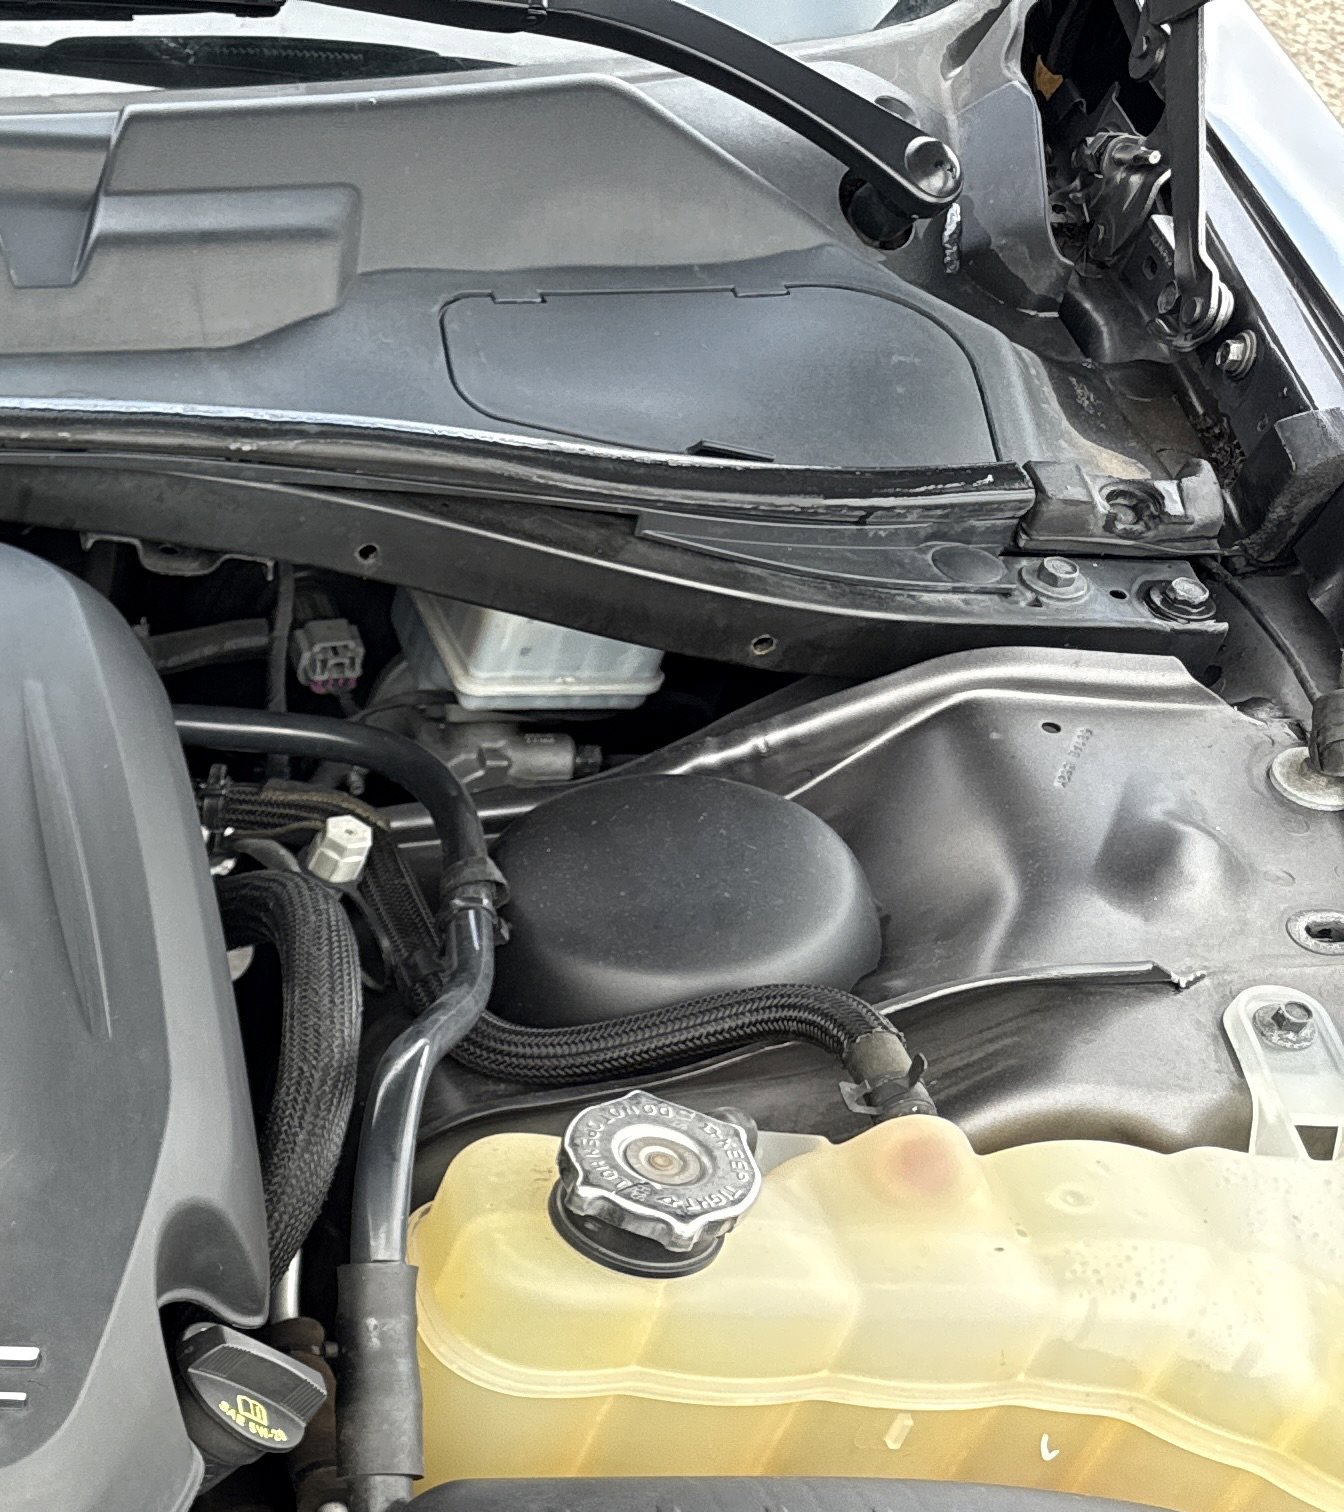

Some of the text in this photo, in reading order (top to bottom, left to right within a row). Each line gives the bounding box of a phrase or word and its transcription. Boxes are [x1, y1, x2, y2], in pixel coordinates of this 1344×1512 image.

[685, 1138, 750, 1211] KEEP TIGHT
[218, 1400, 246, 1427] SAE
